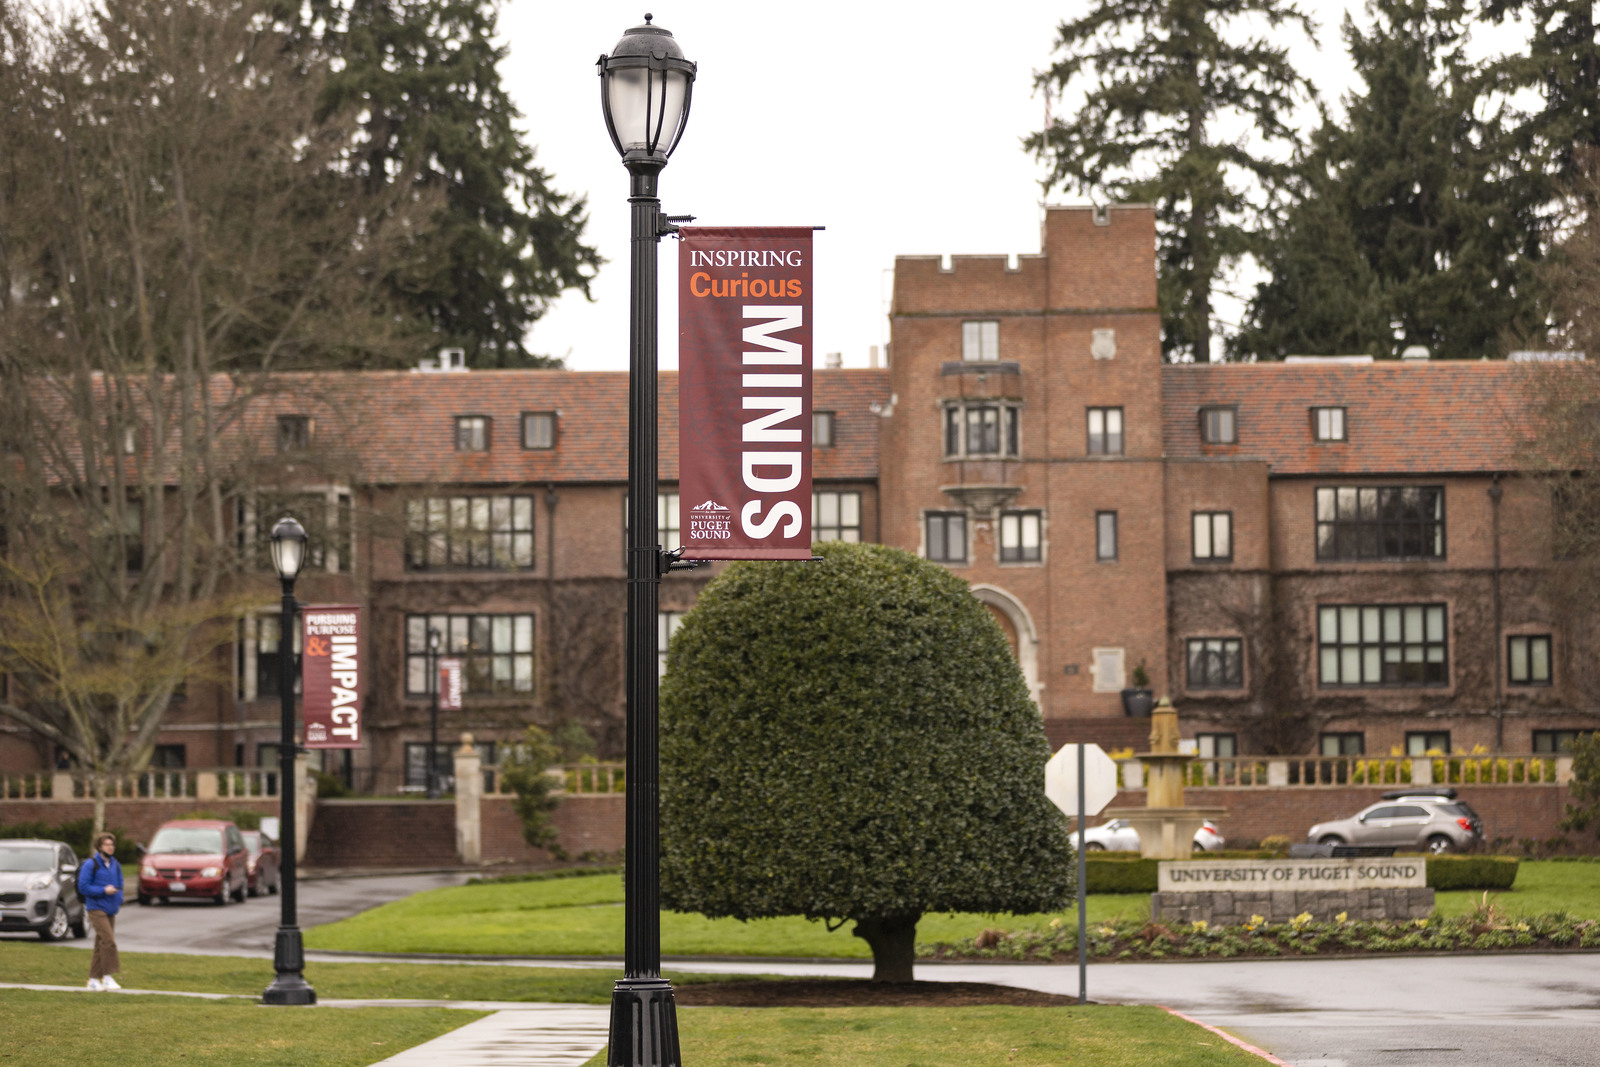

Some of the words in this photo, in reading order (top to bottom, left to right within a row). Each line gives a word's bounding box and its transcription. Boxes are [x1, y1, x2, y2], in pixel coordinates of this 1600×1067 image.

[690, 250, 802, 266] INSPIRING
[690, 272, 802, 297] Curious
[741, 305, 803, 539] MINDS
[690, 521, 731, 530] PUGET
[690, 530, 731, 539] SOUND
[306, 613, 357, 625] PURSUING
[306, 625, 357, 635] PURPOSE
[306, 635, 330, 657] &
[331, 636, 358, 740] IMPACT
[1170, 868, 1269, 882] UNIVERSITY
[1273, 867, 1294, 881] OF
[1299, 866, 1352, 880] PUGET
[1358, 865, 1417, 879] SOUND
